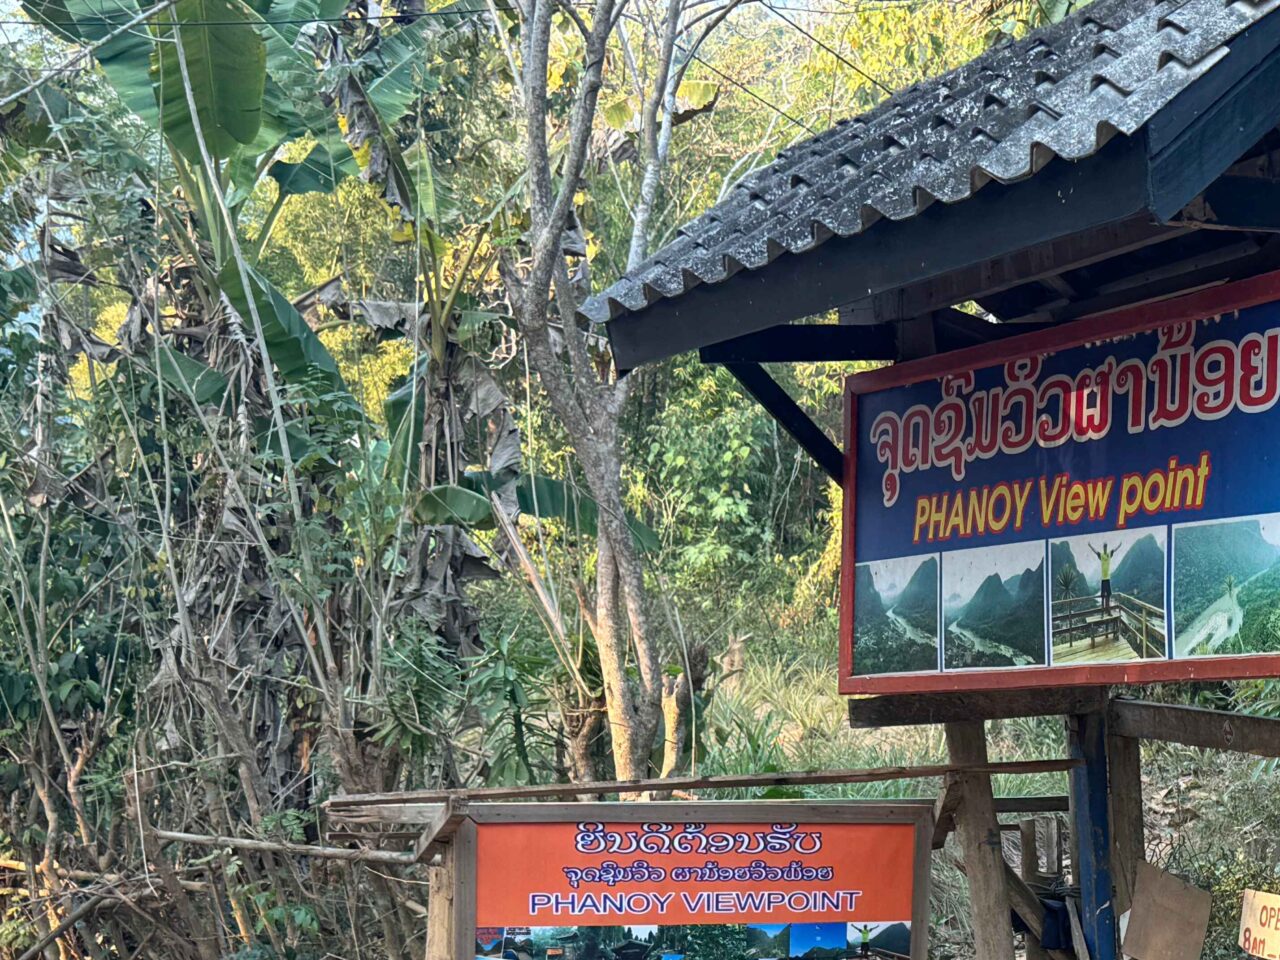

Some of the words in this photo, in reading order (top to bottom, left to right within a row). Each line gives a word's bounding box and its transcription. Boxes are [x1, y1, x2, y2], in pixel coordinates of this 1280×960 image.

[913, 480, 1032, 543] PHANOY
[1040, 472, 1112, 527] View
[1119, 451, 1211, 527] point
[528, 893, 675, 916] PHANOY
[677, 890, 862, 914] VIEWPOINT
